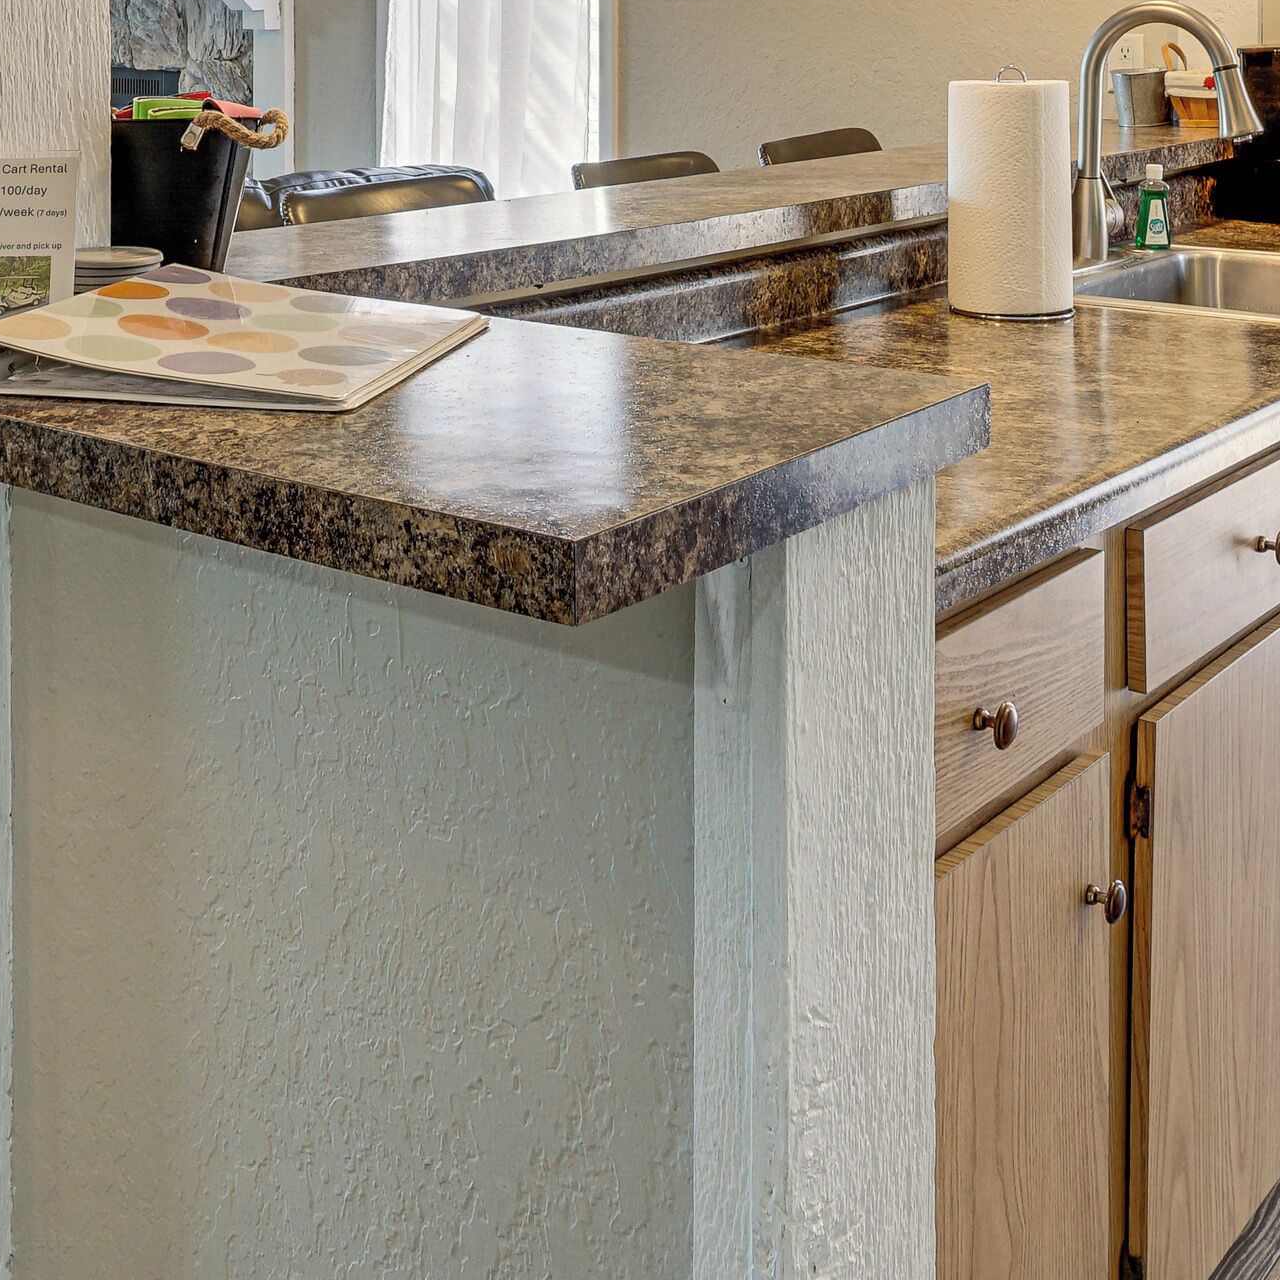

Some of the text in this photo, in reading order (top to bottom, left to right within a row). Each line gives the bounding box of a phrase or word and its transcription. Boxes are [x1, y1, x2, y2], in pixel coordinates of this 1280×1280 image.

[2, 164, 27, 174] Cart
[30, 163, 68, 174] Rental
[46, 209, 67, 218] days)
[16, 242, 32, 250] and
[33, 242, 50, 251] pick
[51, 242, 62, 251] up
